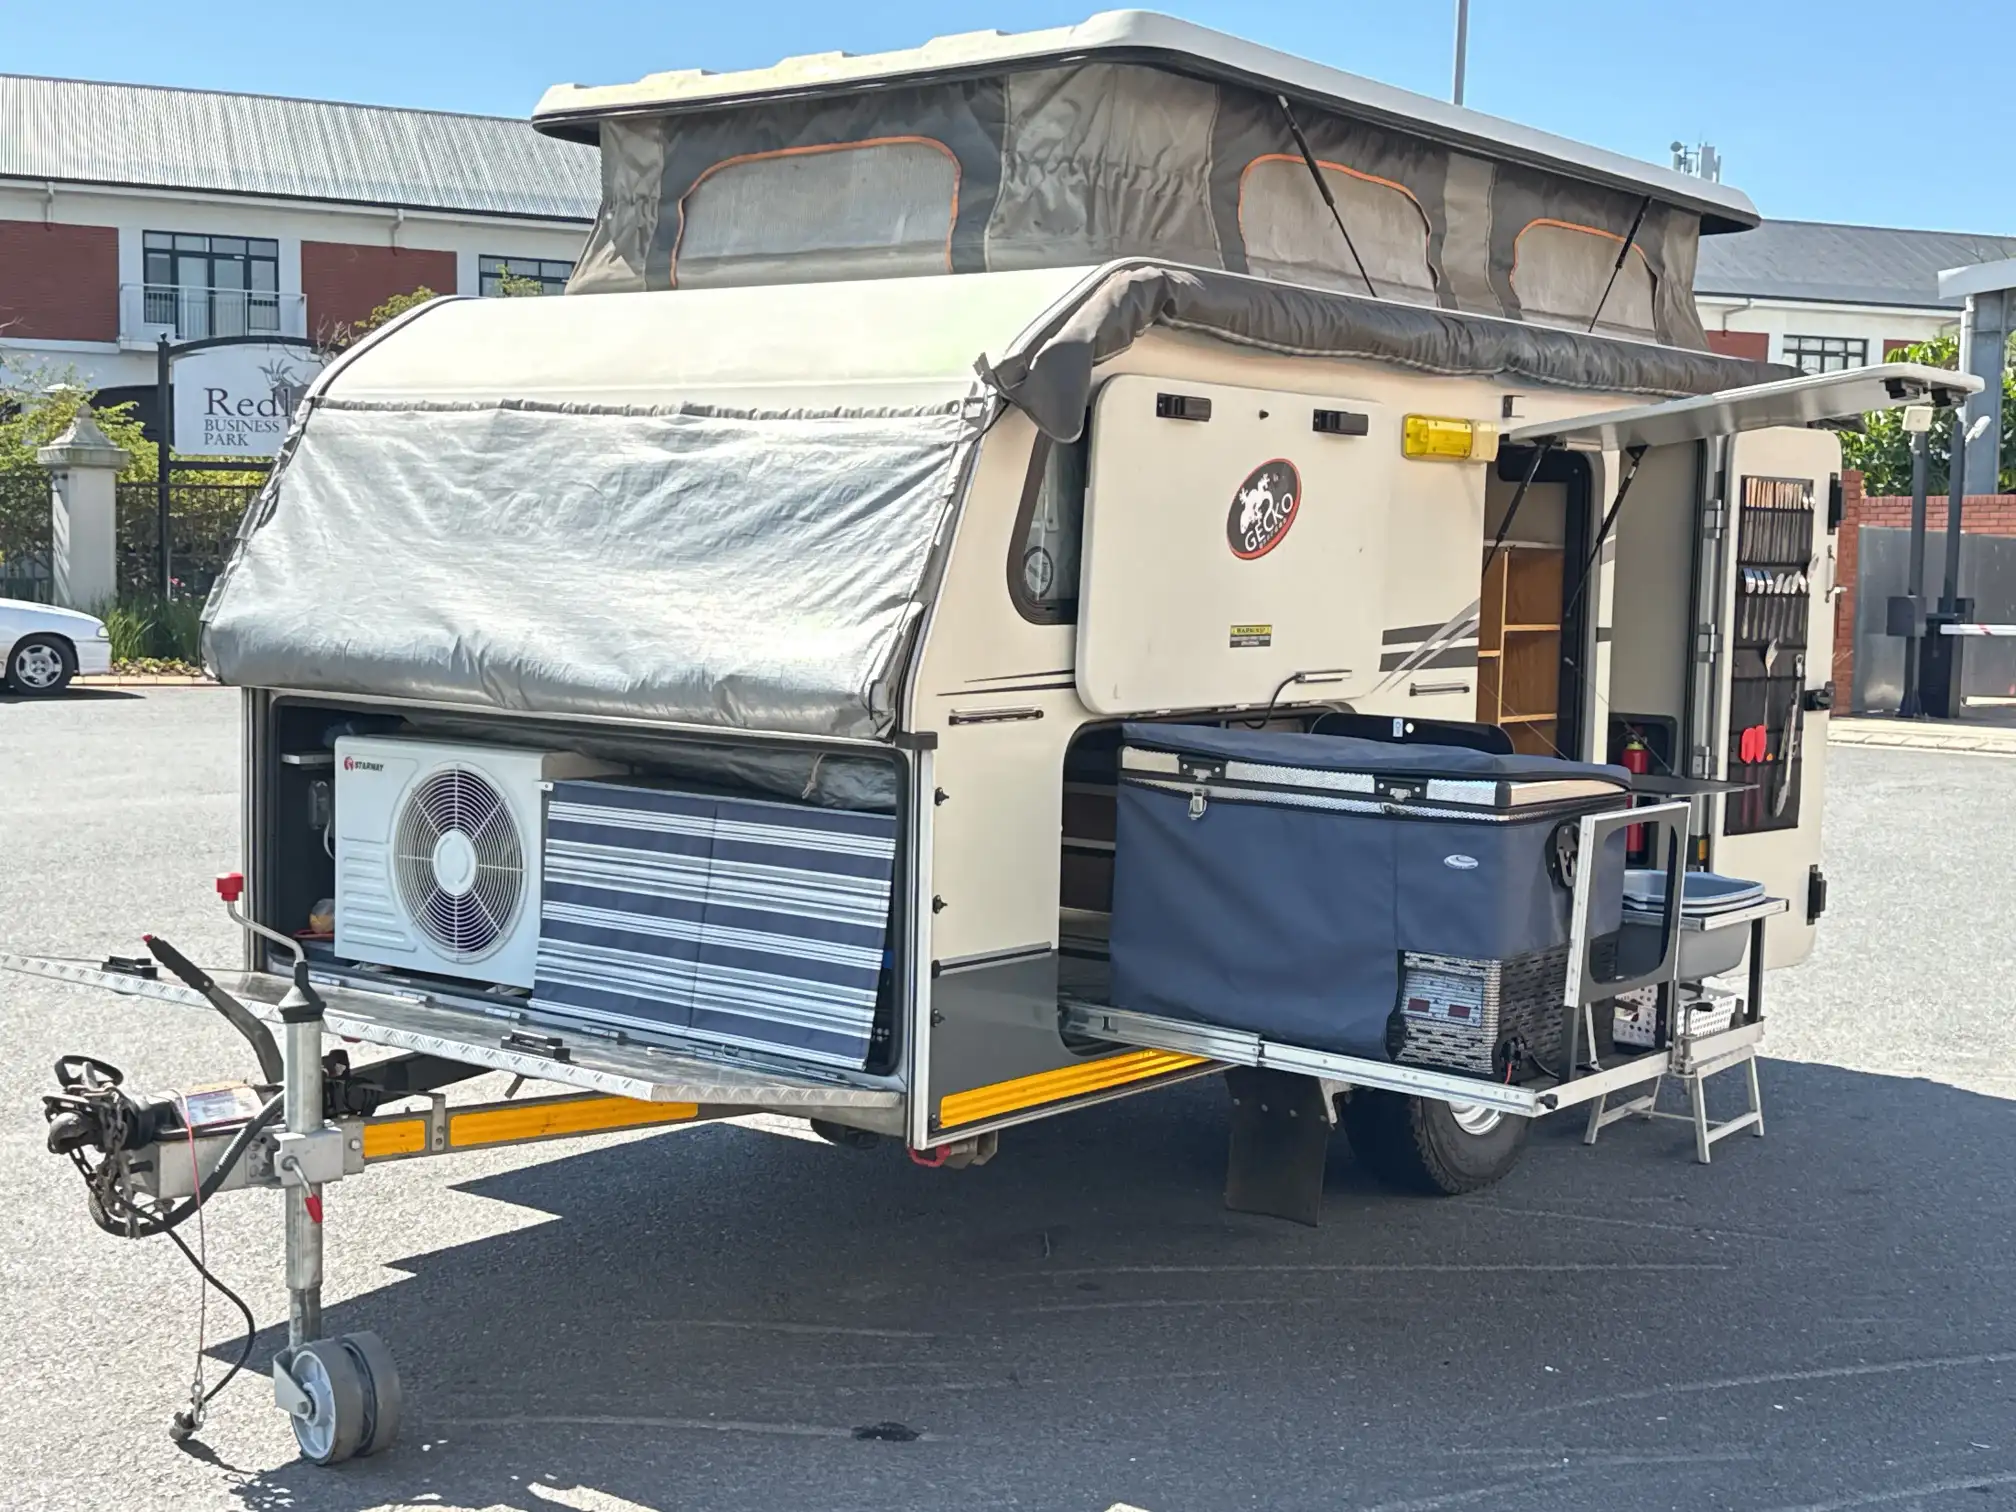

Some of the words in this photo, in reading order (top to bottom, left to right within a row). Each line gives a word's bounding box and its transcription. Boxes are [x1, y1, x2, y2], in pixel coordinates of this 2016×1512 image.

[203, 387, 291, 417] Redl
[204, 419, 280, 433] BUSINESS
[204, 433, 249, 447] PARK
[1244, 492, 1294, 552] GECKO
